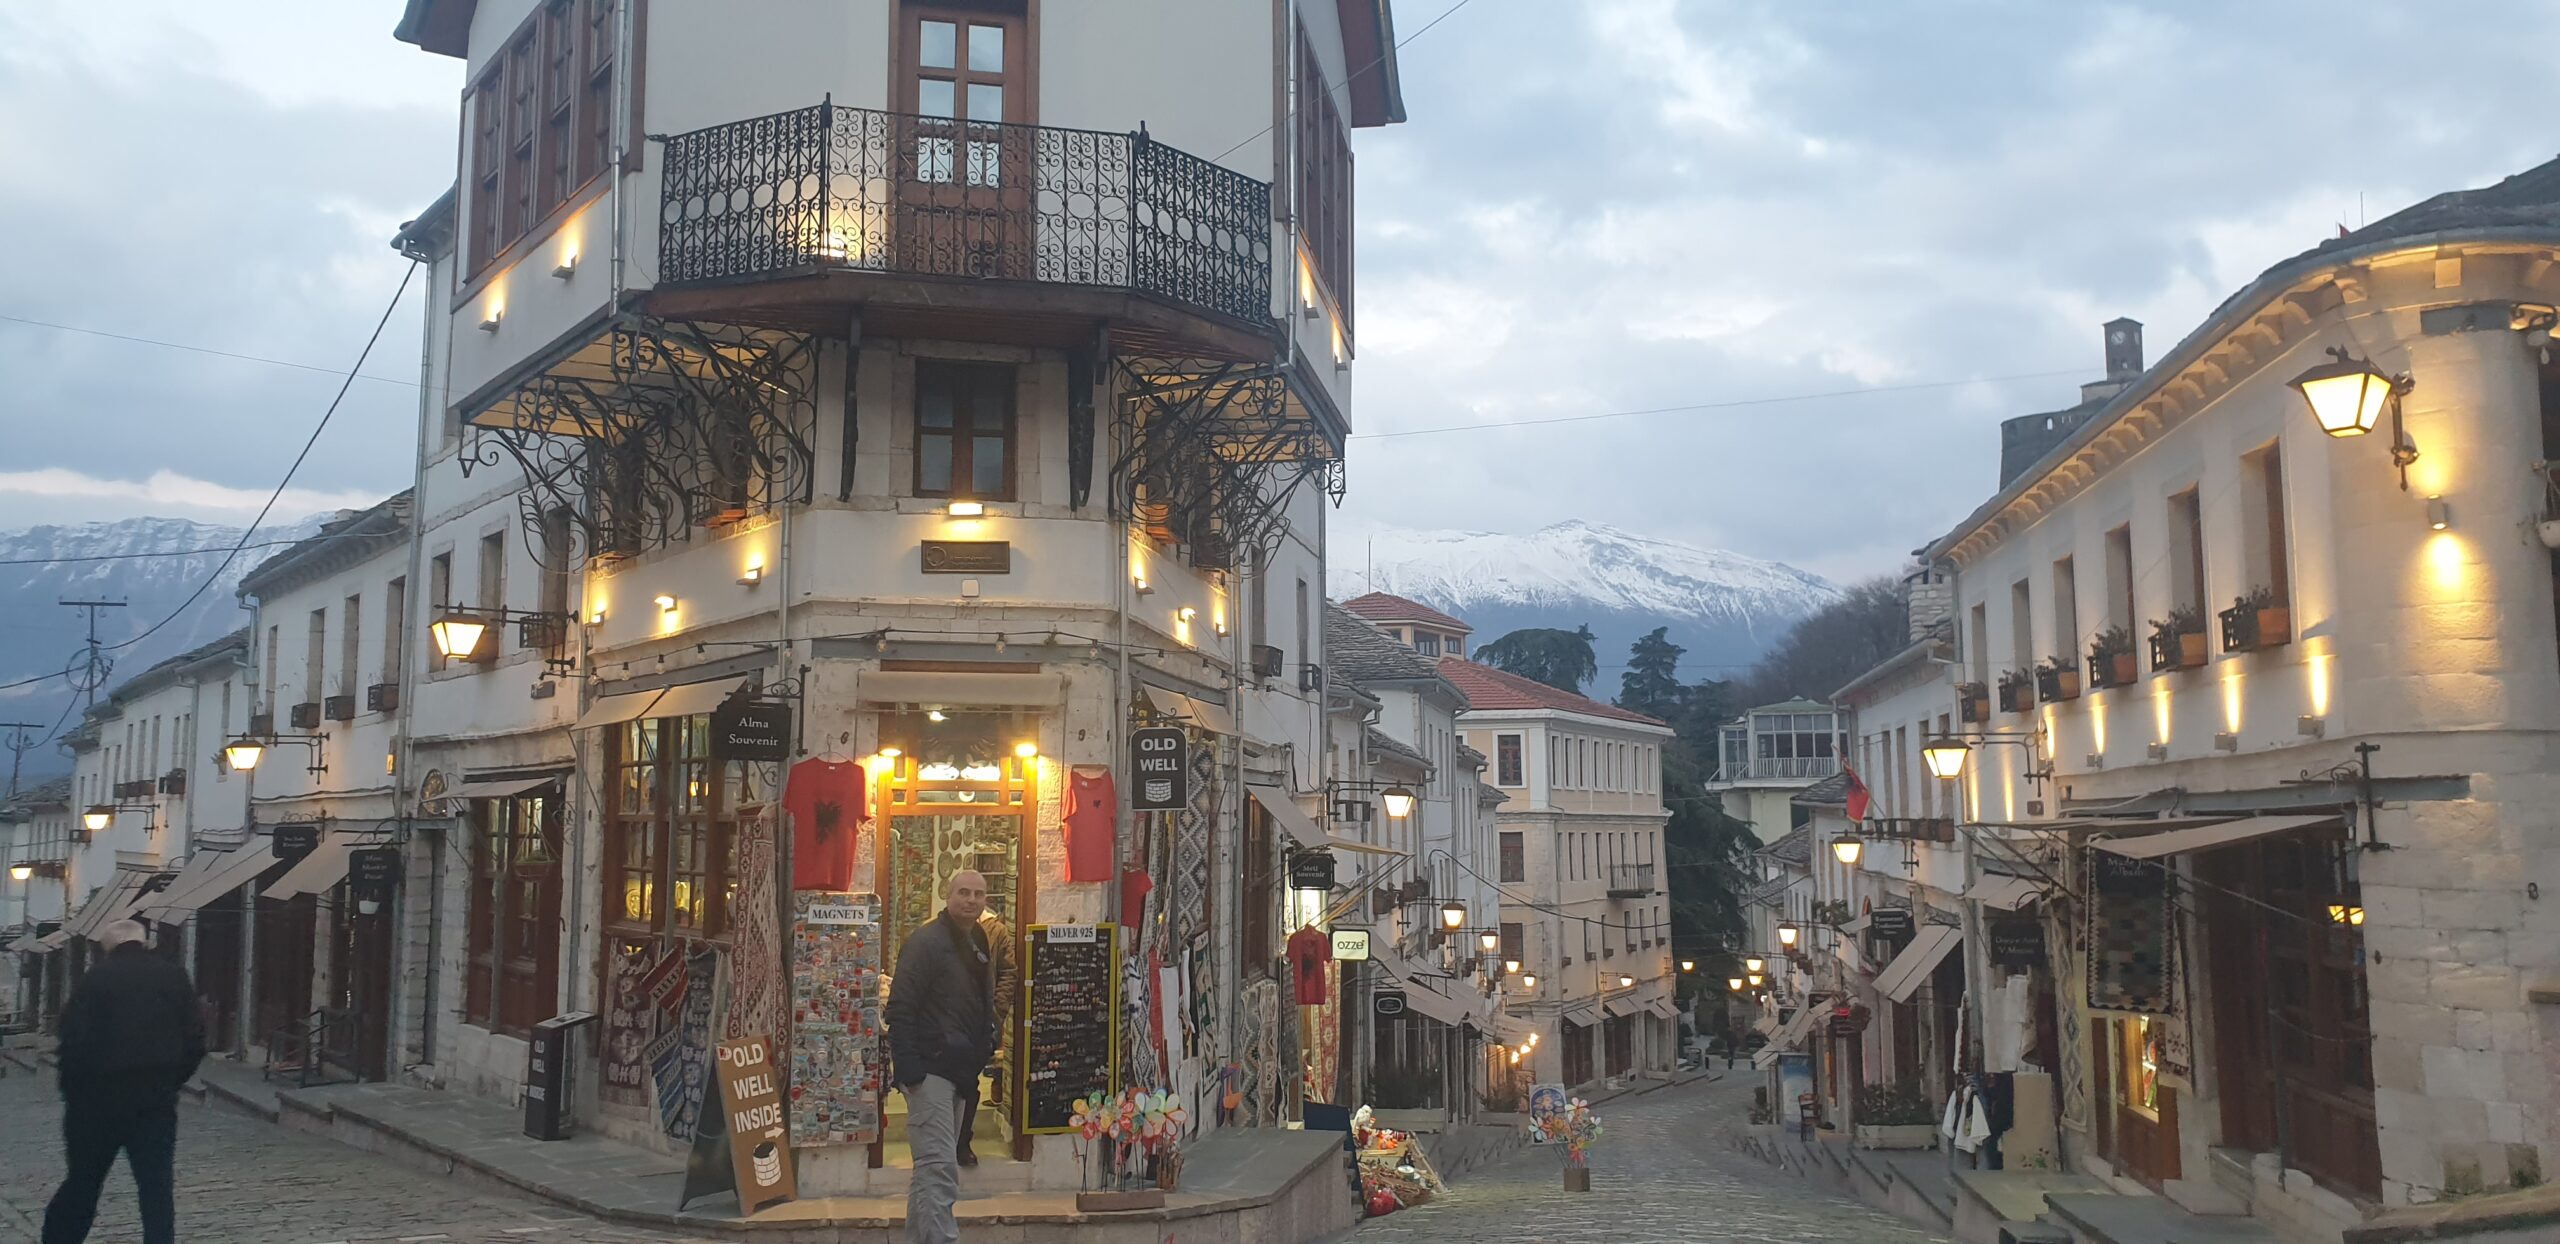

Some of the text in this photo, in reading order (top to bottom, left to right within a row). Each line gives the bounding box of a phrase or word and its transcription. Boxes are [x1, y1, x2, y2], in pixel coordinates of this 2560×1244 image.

[739, 716, 769, 729] Alma
[728, 733, 779, 746] Souvenir
[1140, 737, 1177, 752] OLD
[1139, 758, 1179, 772] WELL
[812, 908, 865, 920] MAGNETS
[1050, 927, 1094, 939] SILVER 925
[732, 1043, 764, 1068] OLD
[733, 1073, 774, 1100] WELL
[734, 1102, 782, 1134] INSIDE
